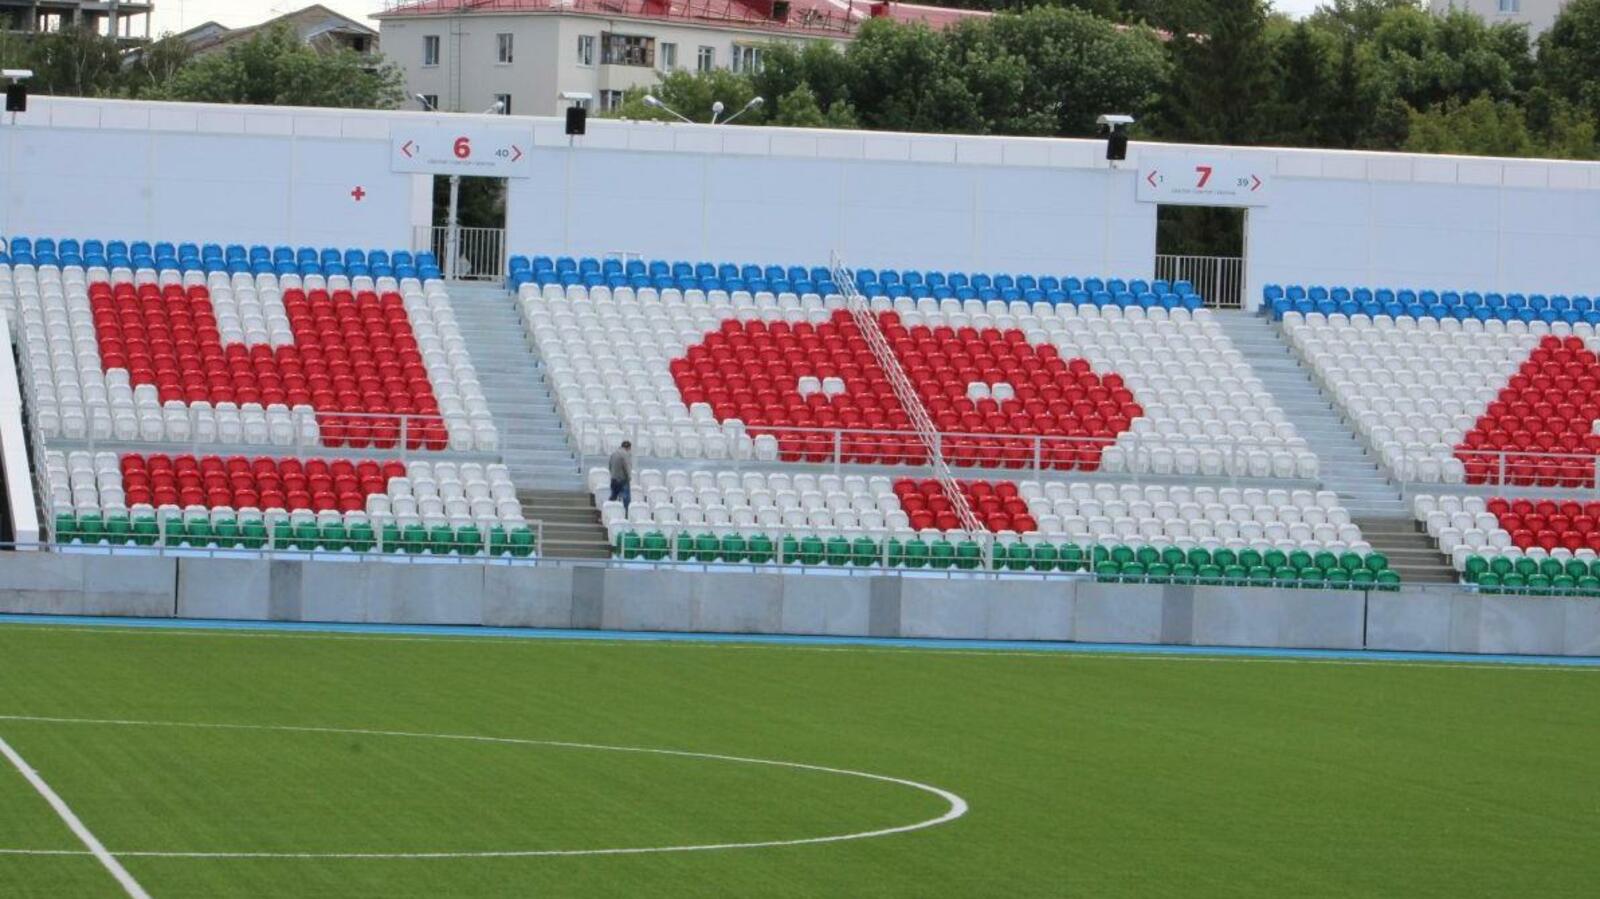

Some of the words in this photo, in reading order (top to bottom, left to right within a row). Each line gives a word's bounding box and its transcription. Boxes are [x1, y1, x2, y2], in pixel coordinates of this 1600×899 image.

[453, 136, 471, 159] 6
[495, 148, 510, 158] 40
[1195, 166, 1213, 188] 7
[1236, 178, 1249, 187] 39
